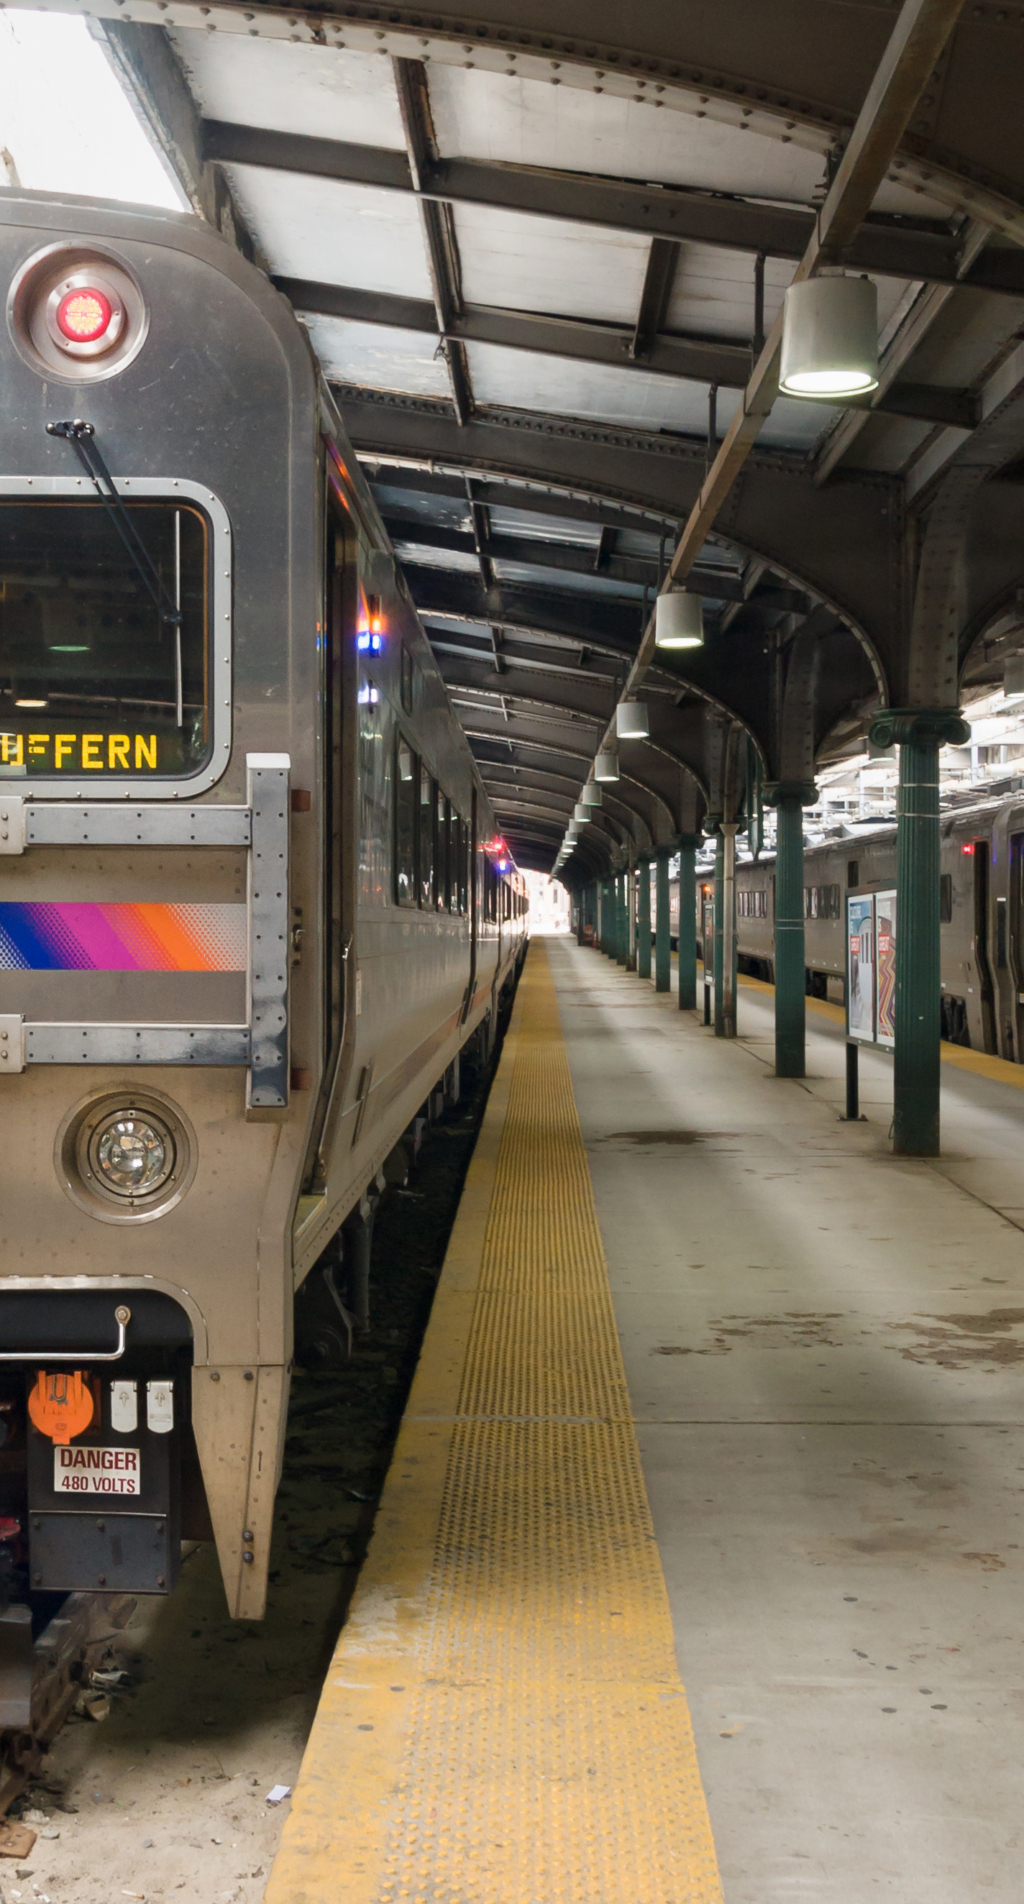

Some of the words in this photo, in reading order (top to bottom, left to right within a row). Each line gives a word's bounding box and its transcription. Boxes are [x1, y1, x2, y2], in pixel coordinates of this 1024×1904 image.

[59, 1448, 137, 1471] DANGER
[61, 1475, 89, 1491] 480
[92, 1477, 136, 1494] VOLTS
